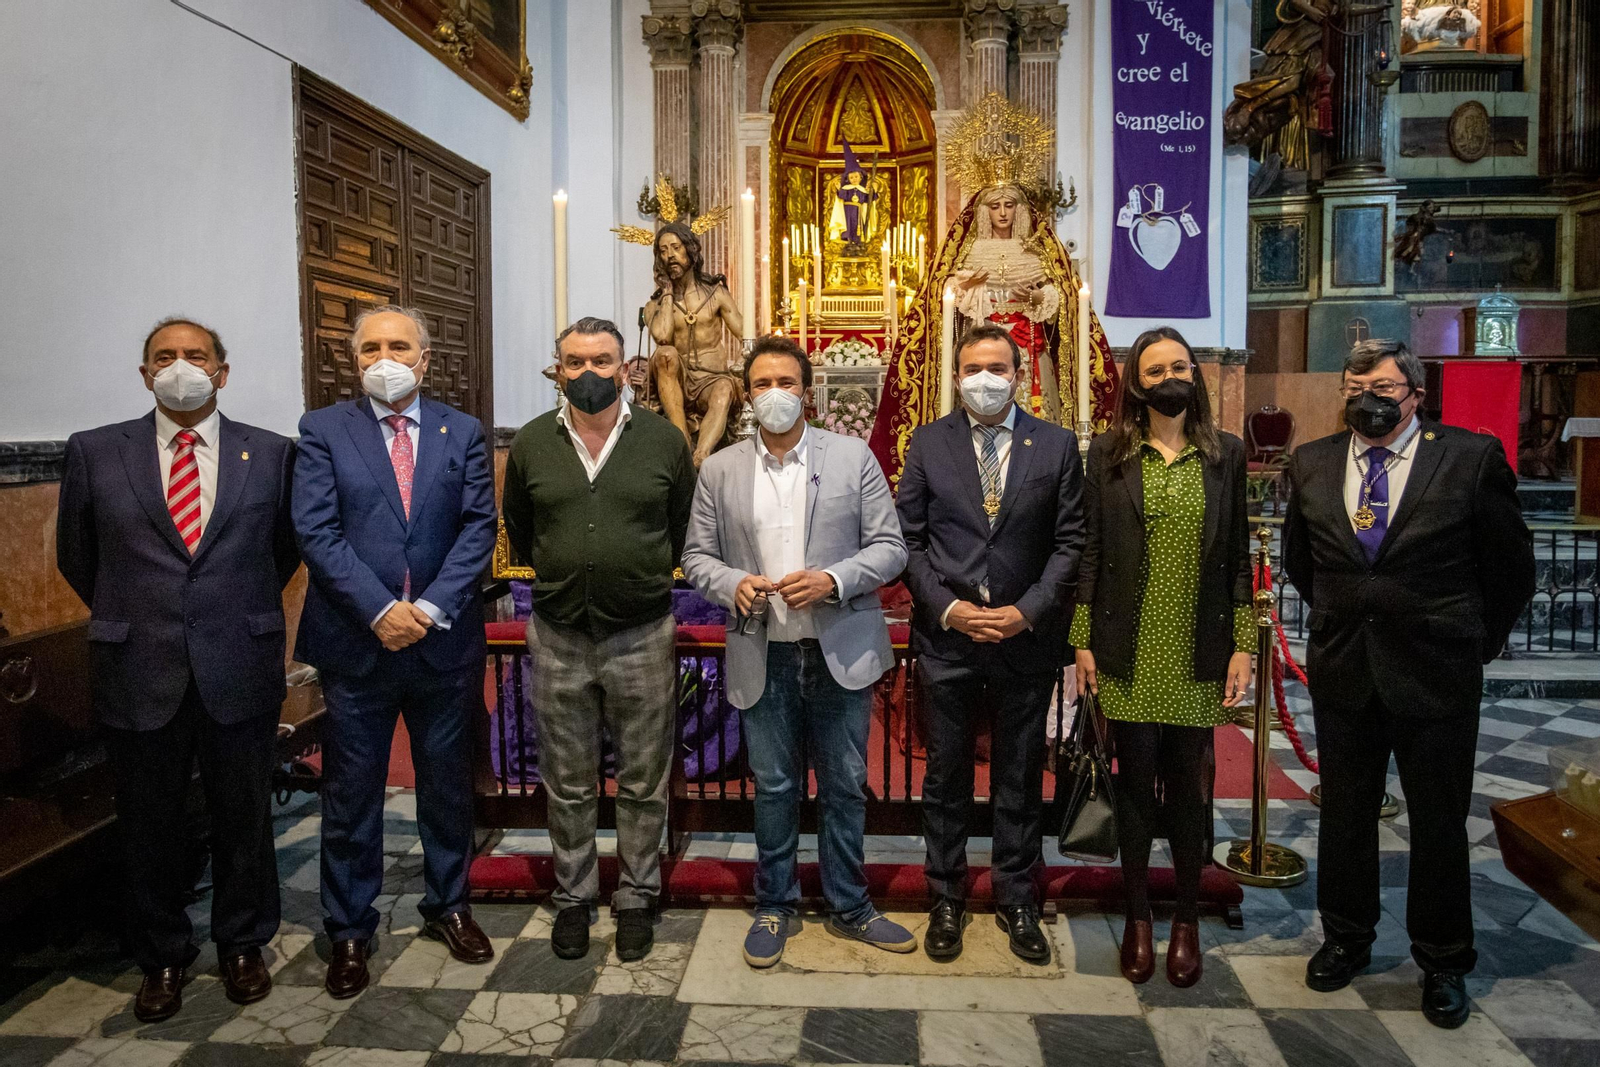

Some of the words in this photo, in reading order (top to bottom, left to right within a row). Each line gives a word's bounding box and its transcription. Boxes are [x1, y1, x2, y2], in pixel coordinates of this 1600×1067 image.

[1136, 33, 1150, 55] y
[1117, 66, 1161, 83] cree
[1170, 62, 1189, 82] el
[1116, 111, 1205, 134] evangelio
